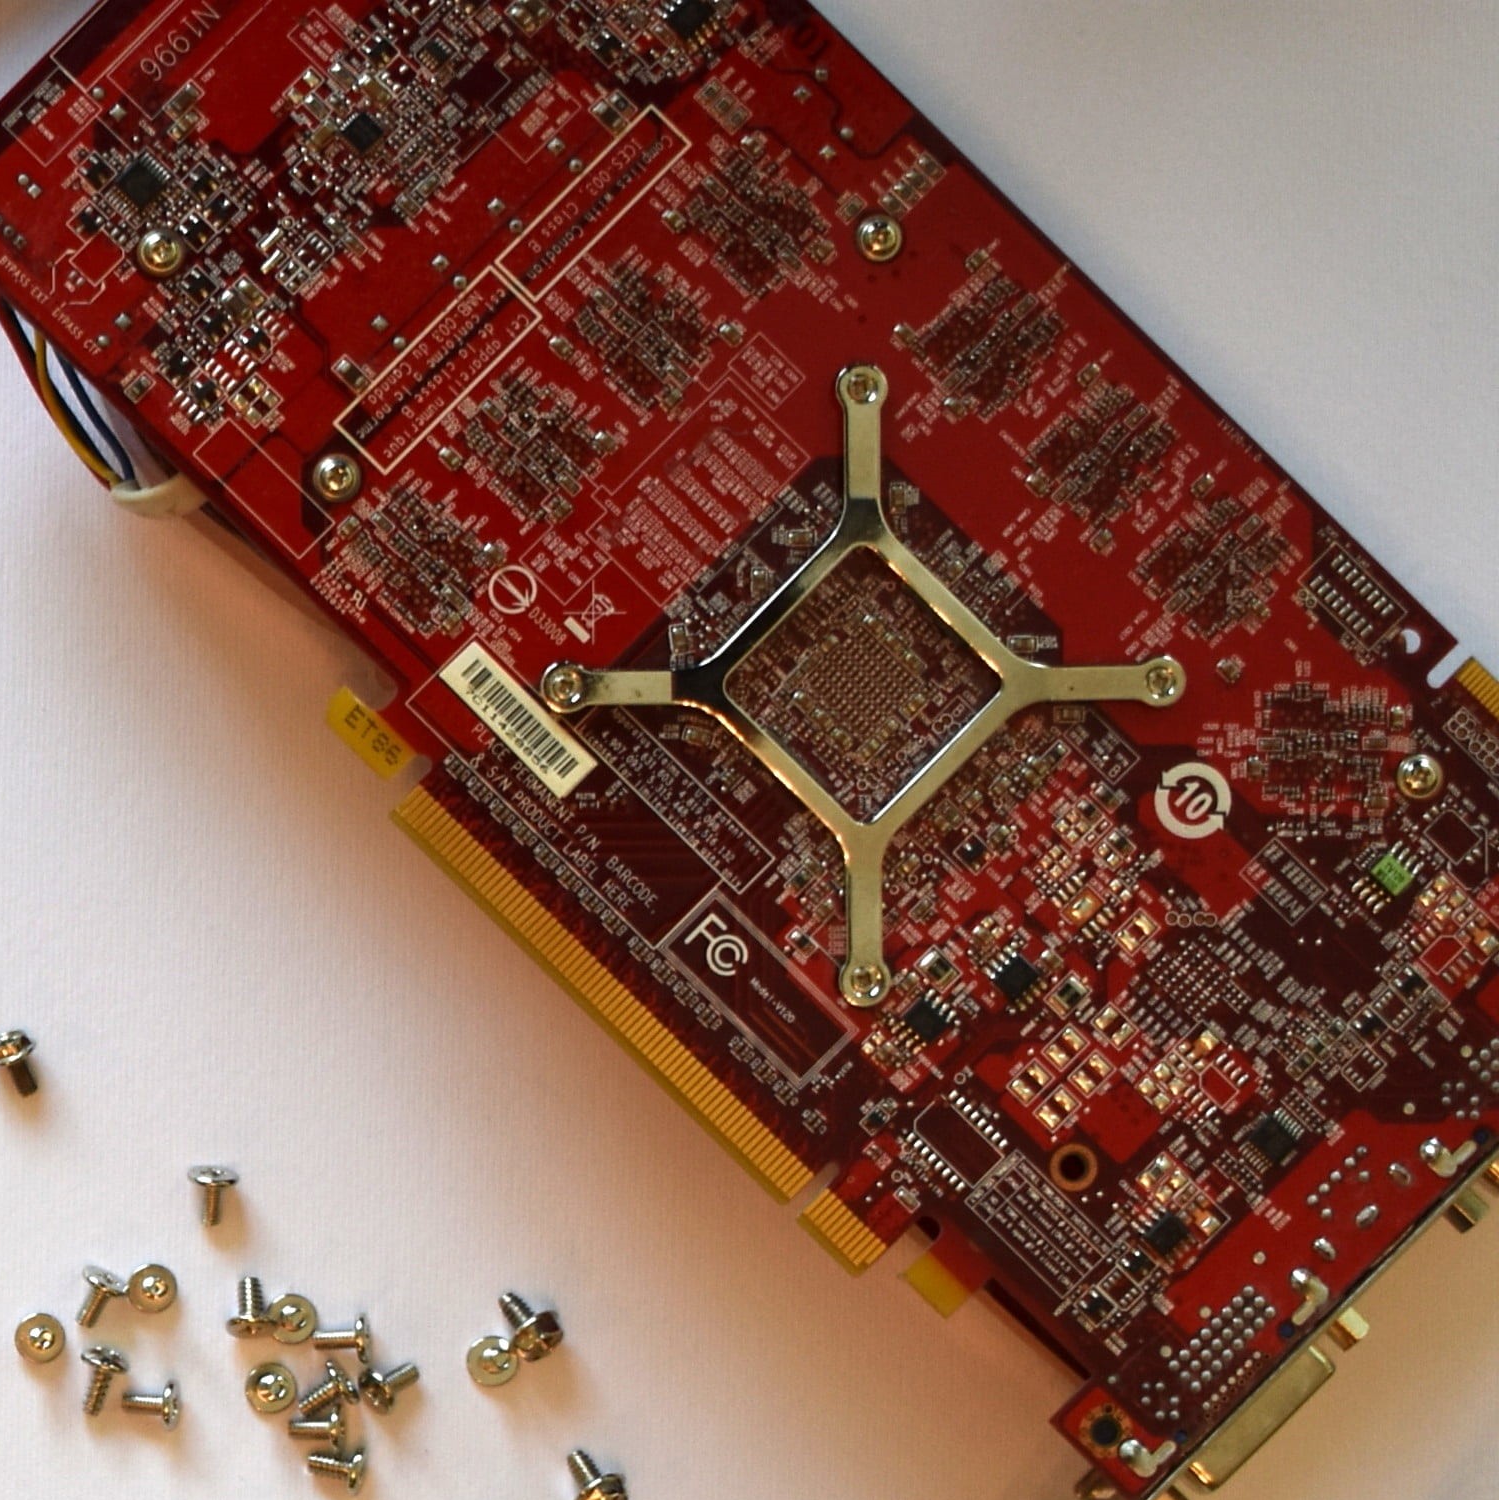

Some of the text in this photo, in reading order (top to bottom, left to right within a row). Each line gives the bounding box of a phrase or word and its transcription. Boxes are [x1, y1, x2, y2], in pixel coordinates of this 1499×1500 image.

[136, 0, 221, 84] N1996
[469, 720, 511, 762] PLACE
[508, 759, 575, 826] PERMANENT
[1173, 781, 1211, 818] 10
[484, 764, 513, 793] S/N
[509, 788, 564, 843] PRODUCT
[560, 839, 602, 880] LABEL
[599, 877, 634, 913] HERE
